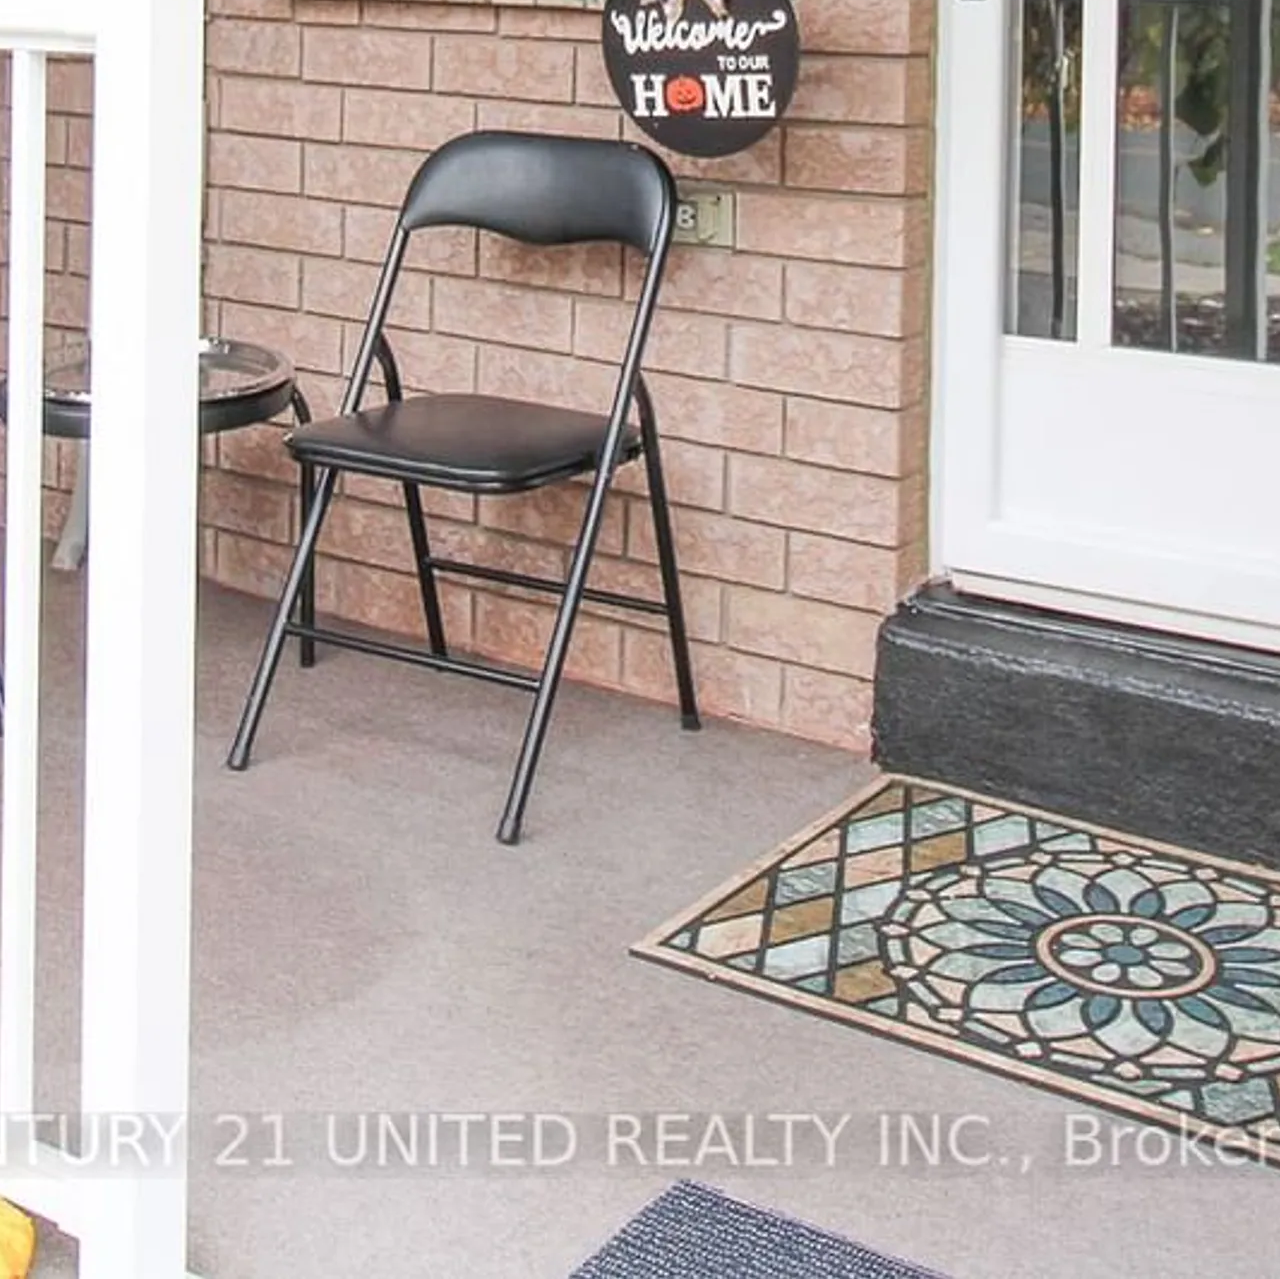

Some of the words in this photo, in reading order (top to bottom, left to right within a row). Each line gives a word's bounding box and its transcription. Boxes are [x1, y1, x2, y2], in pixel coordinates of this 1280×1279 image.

[611, 8, 787, 55] Welcome
[717, 55, 737, 70] TO
[738, 55, 769, 70] OUR
